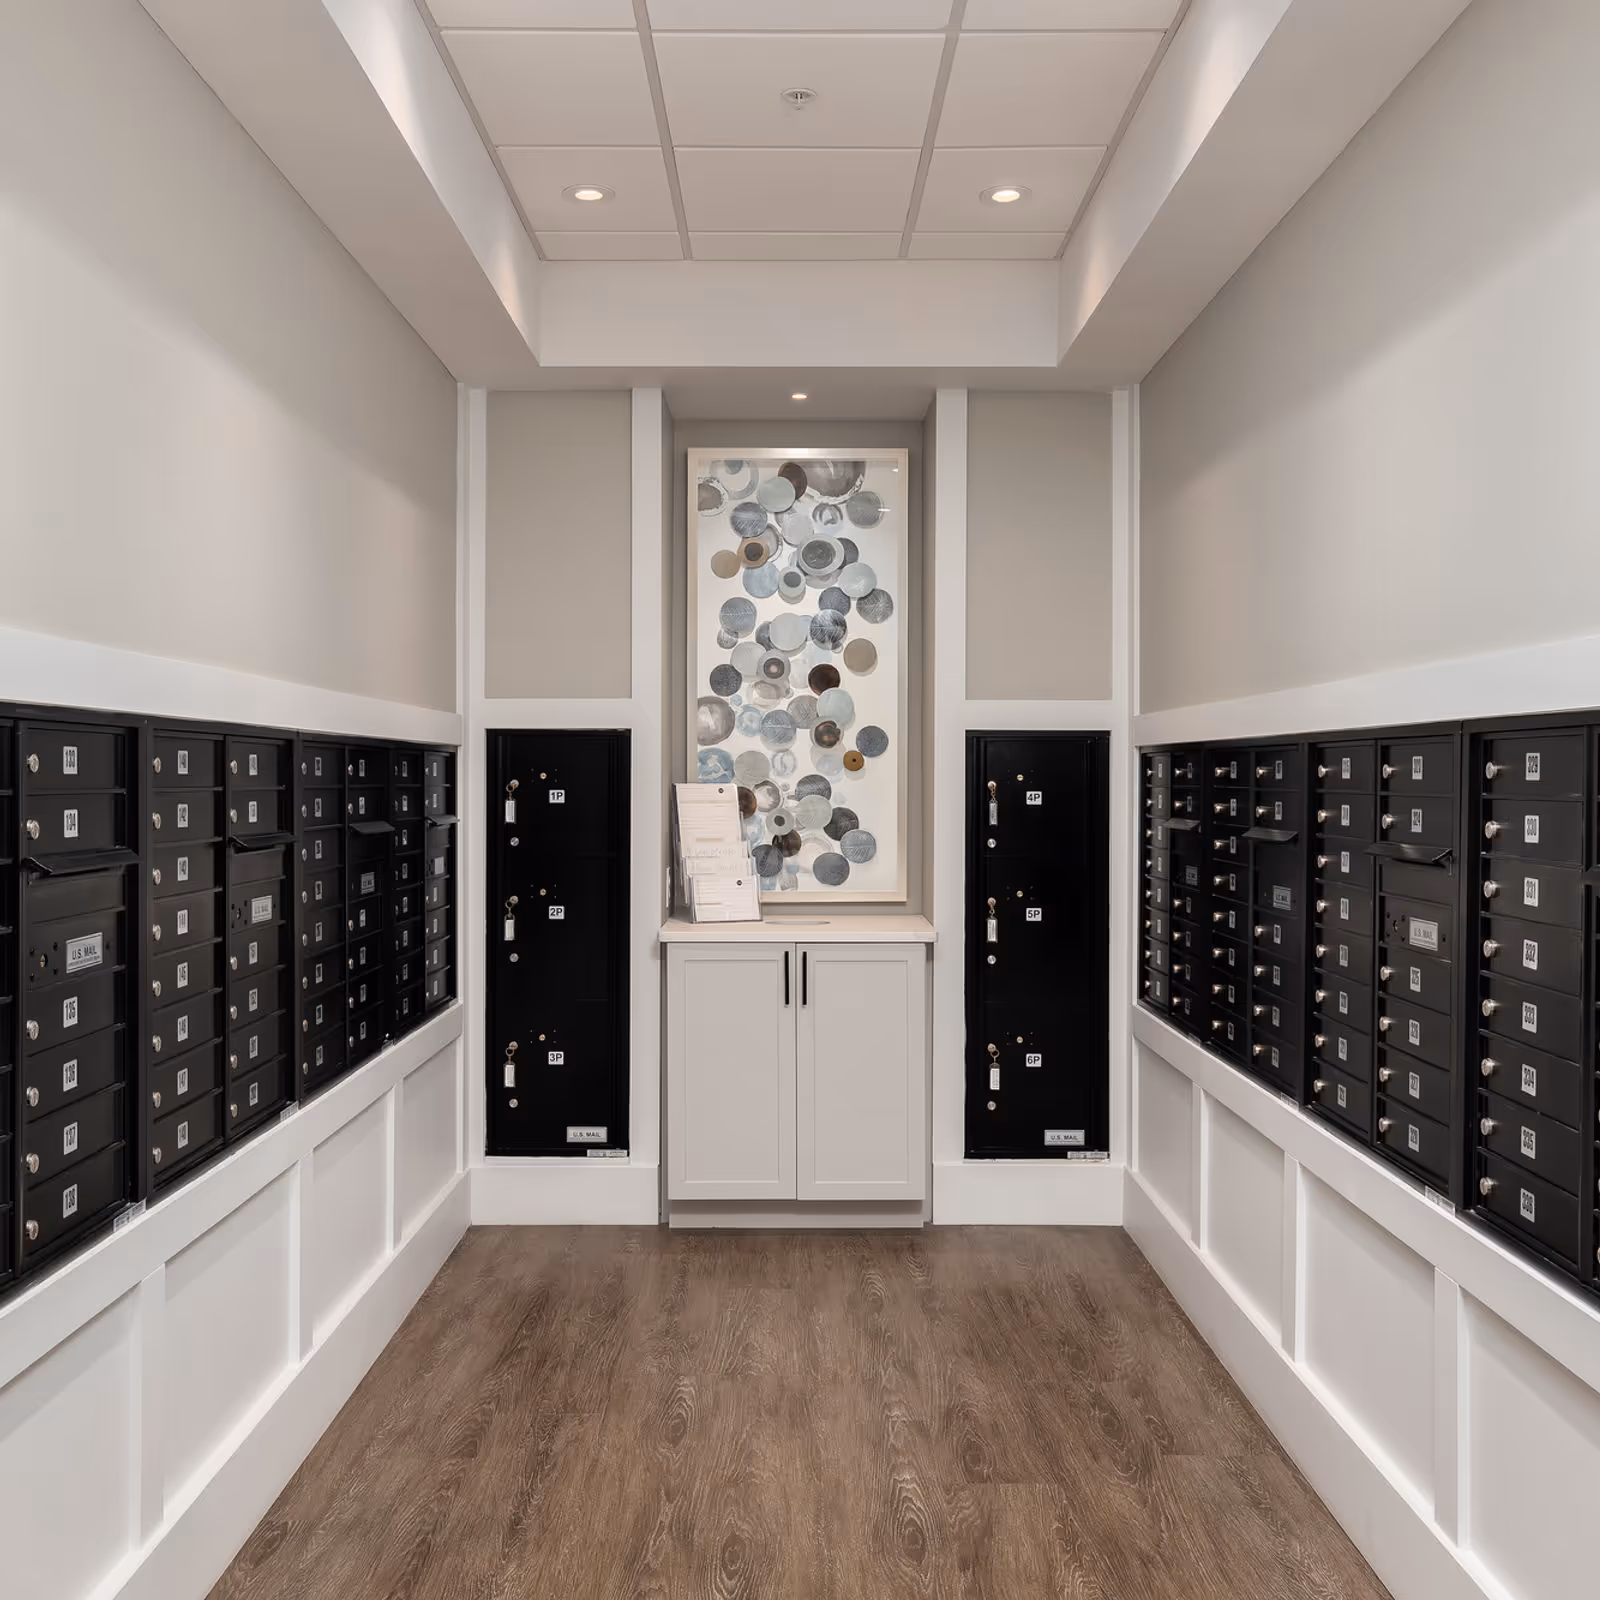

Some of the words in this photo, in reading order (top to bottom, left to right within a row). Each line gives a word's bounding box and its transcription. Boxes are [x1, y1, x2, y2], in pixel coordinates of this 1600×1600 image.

[550, 792, 563, 800] 1P
[1027, 793, 1040, 802] 4P
[66, 813, 77, 831] 134
[1527, 881, 1537, 899] 331
[550, 908, 563, 916] 2P
[1027, 910, 1040, 918] 5P
[84, 944, 97, 957] MAIL
[549, 1053, 562, 1062] 3P
[1027, 1056, 1040, 1064] 6P
[1524, 1068, 1535, 1088] 334
[1523, 1130, 1534, 1150] 335
